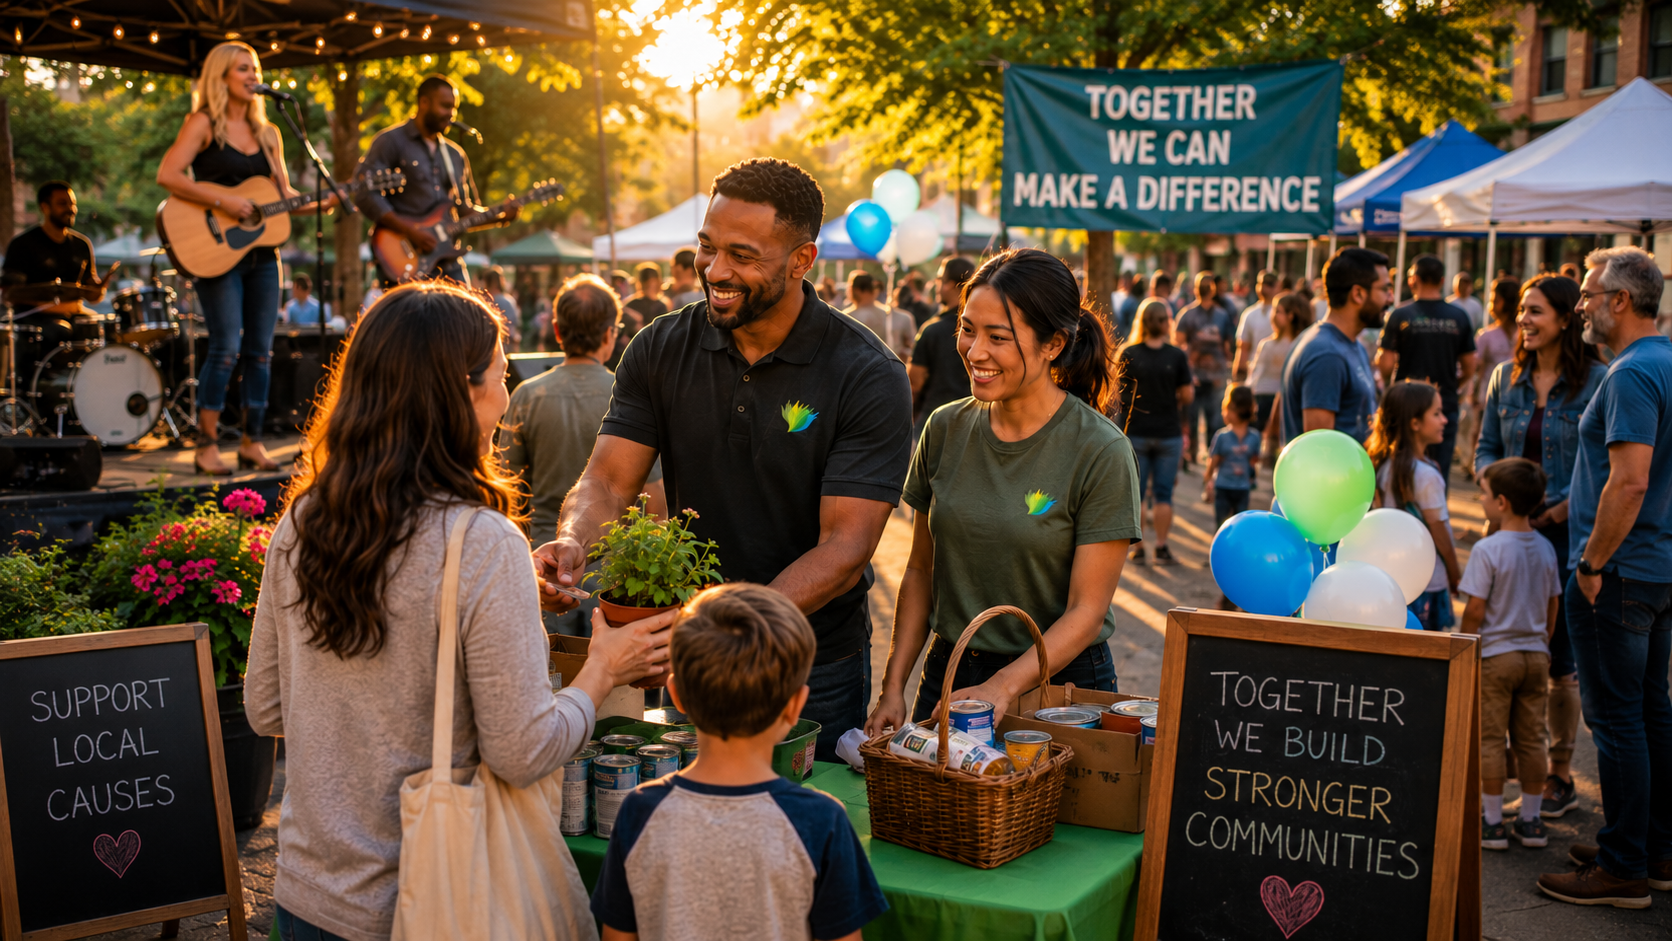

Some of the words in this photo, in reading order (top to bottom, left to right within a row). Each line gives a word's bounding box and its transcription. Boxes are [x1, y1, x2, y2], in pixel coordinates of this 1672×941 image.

[1085, 84, 1257, 121] TOGETHER
[1108, 129, 1157, 165] WE
[1165, 130, 1231, 166] CAN
[1013, 171, 1099, 209] MAKE
[1105, 175, 1128, 210] A
[1137, 175, 1321, 213] DIFFERENCE
[30, 676, 170, 723] SUPPORT
[1210, 670, 1406, 727] TOGETHER
[52, 726, 160, 768] LOCAL
[1214, 719, 1264, 754] WE
[1284, 726, 1386, 767] BUILD
[46, 774, 176, 822] CAUSES
[1204, 765, 1393, 824] STRONGER
[1185, 810, 1420, 880] COMMUNITIES
